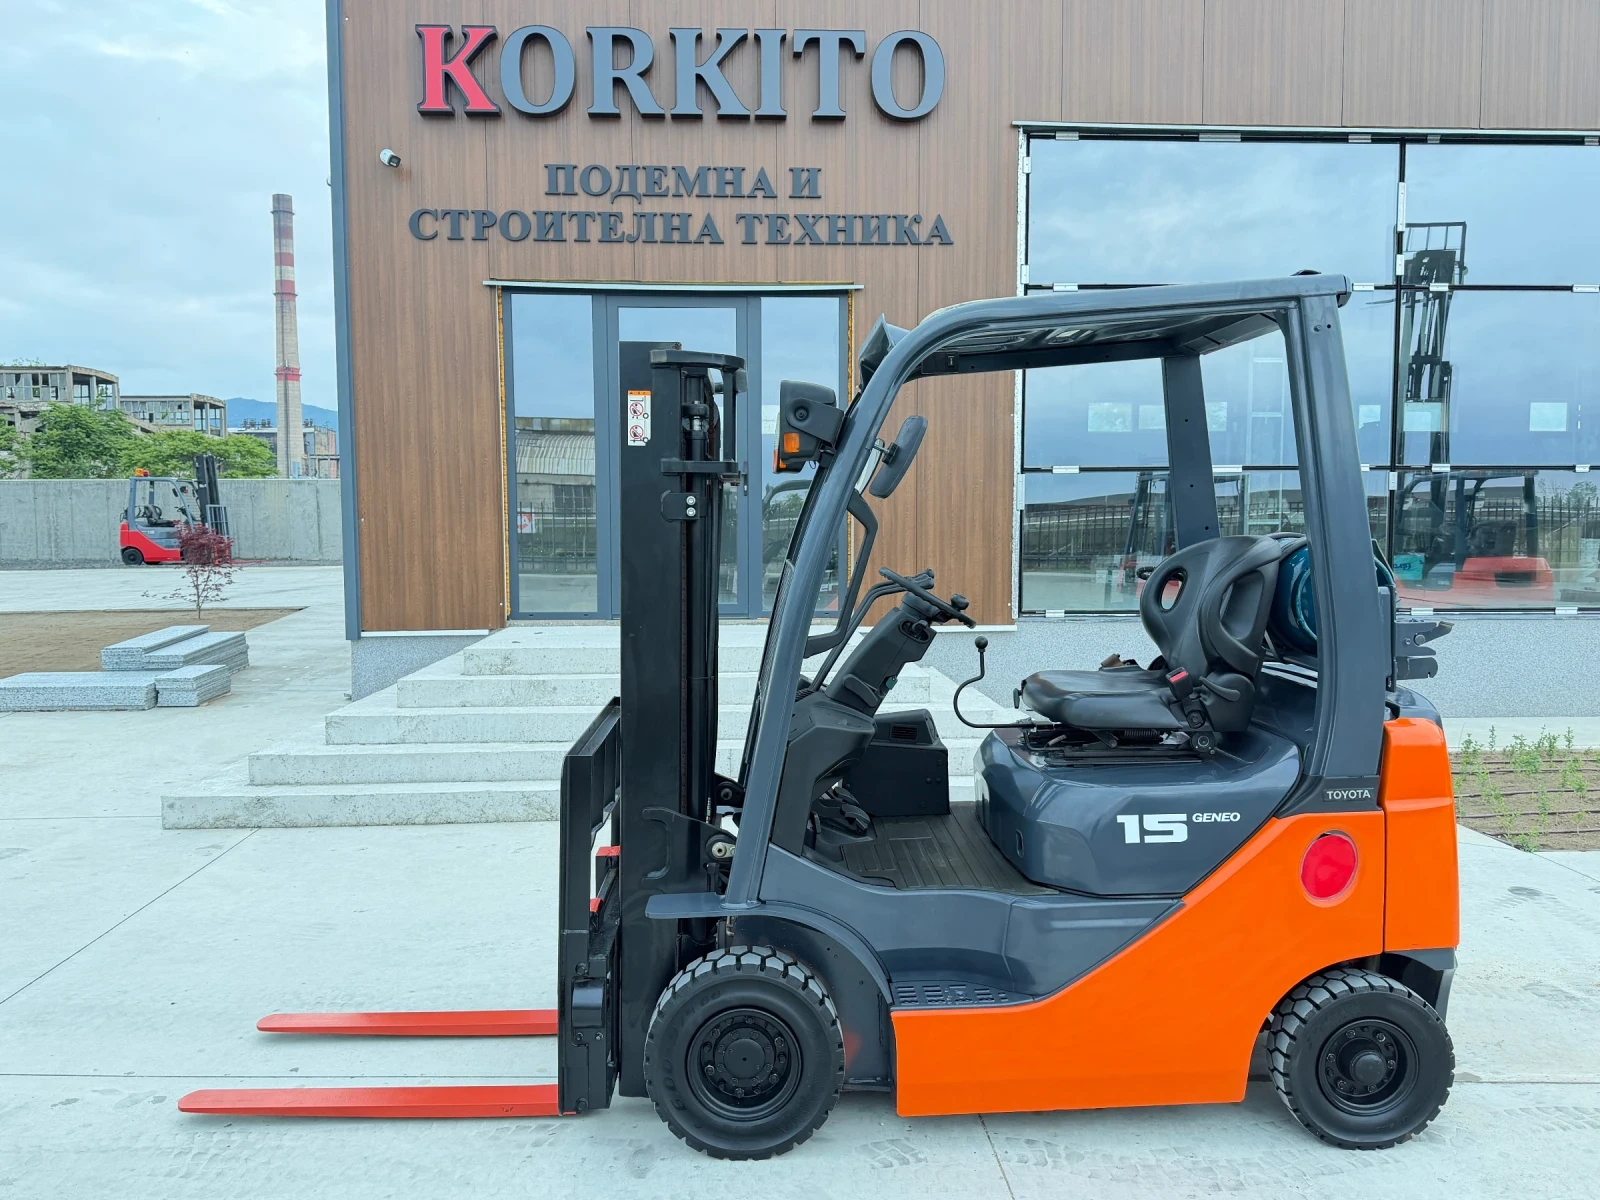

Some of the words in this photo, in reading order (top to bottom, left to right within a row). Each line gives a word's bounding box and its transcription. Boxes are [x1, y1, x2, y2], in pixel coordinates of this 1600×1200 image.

[415, 24, 946, 122] KORKITO
[544, 163, 777, 204] ПОДЕМНА
[789, 167, 822, 199] И
[408, 208, 724, 244] СТРОИТЕЛНА
[735, 213, 954, 246] ТЕХНИКА
[1326, 789, 1371, 800] TOYOTA
[1116, 813, 1188, 844] 15
[1192, 812, 1241, 823] GENEO
